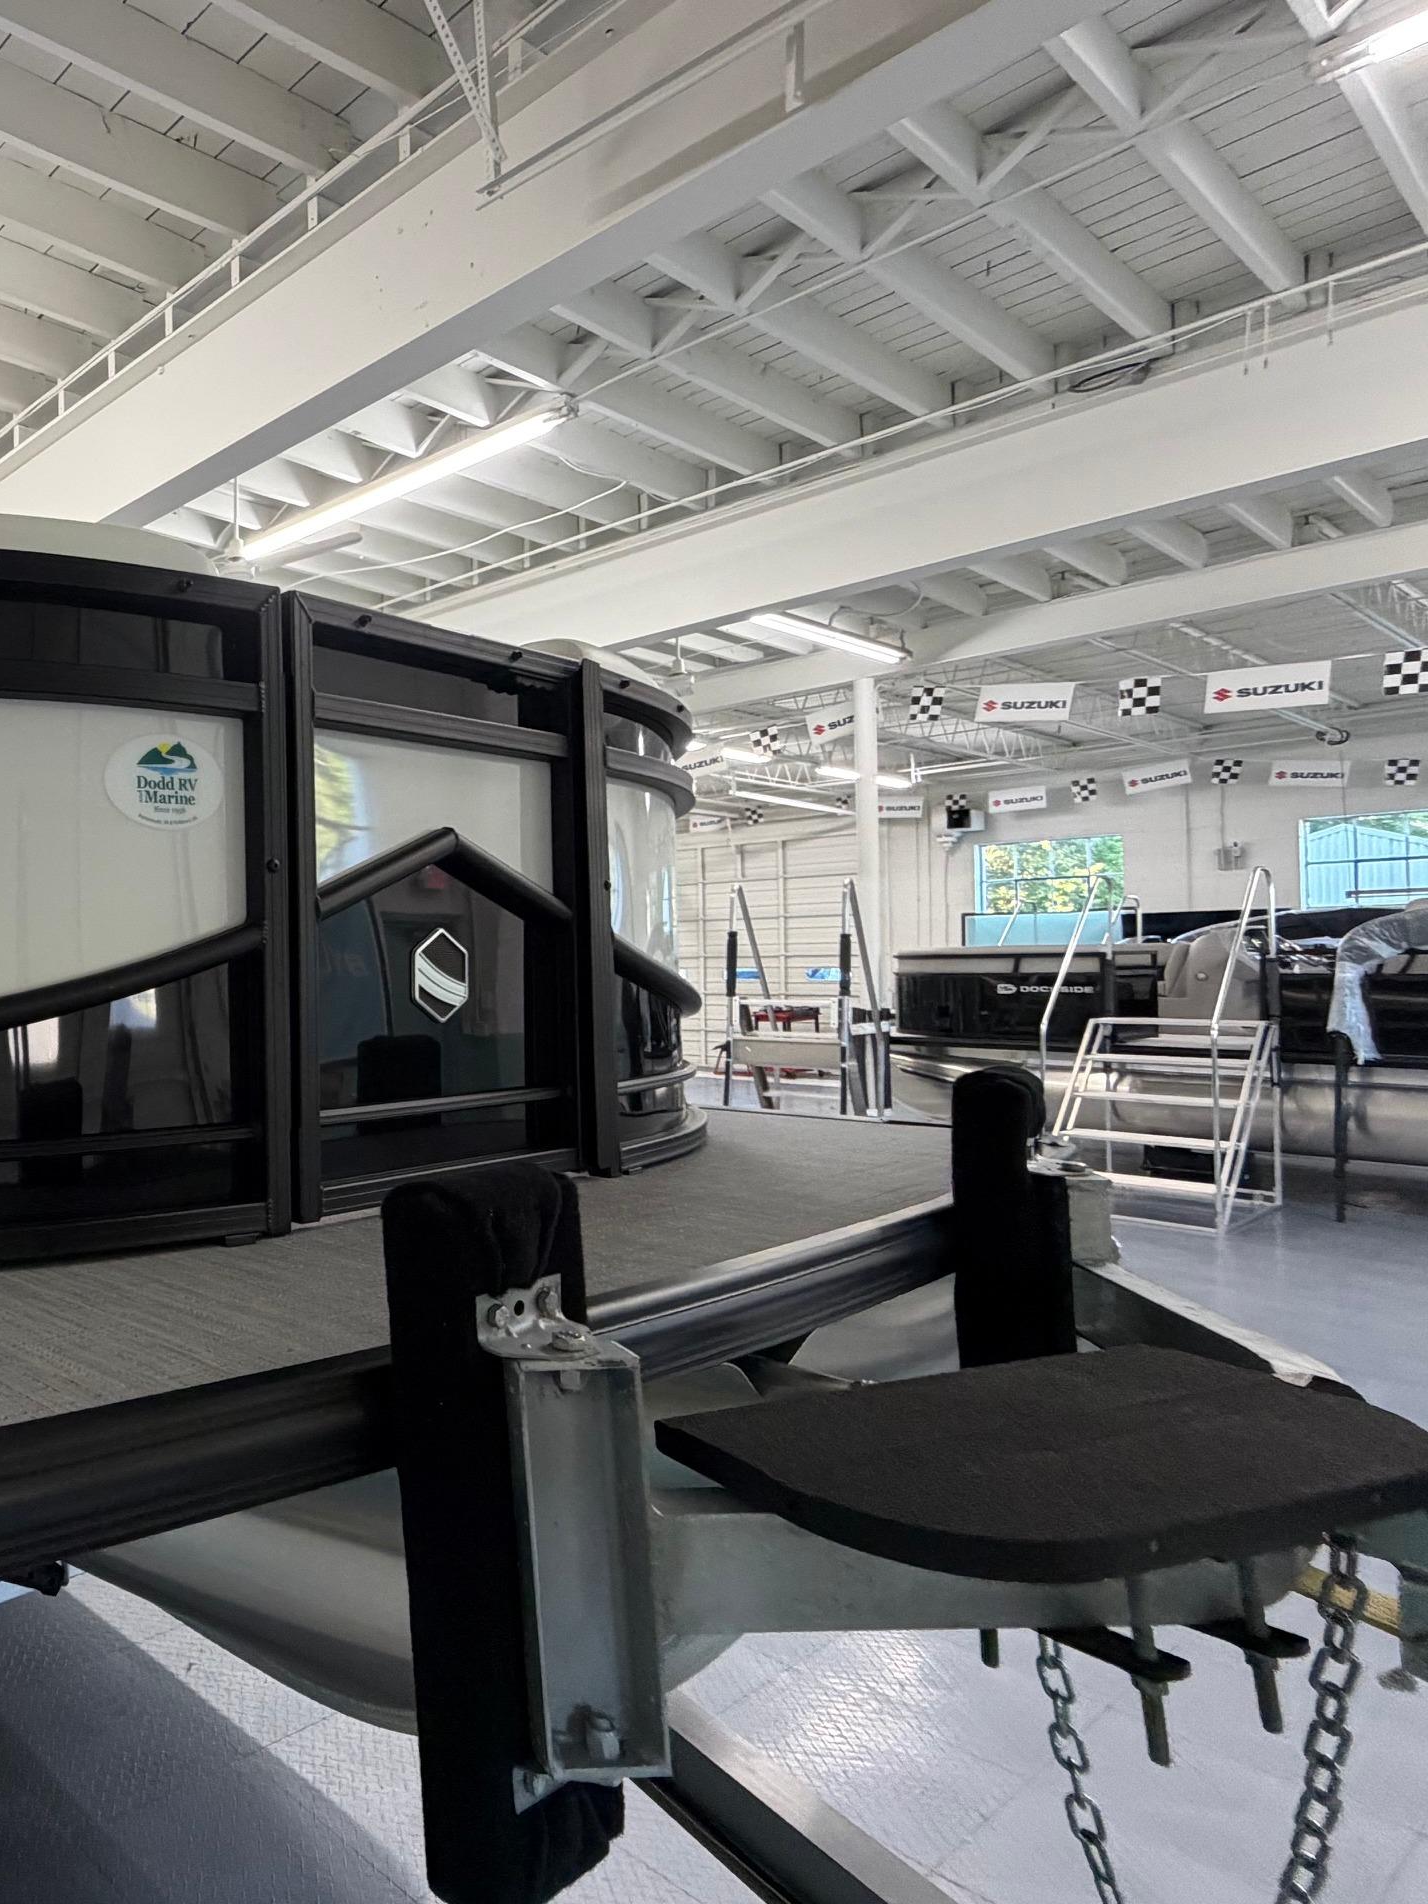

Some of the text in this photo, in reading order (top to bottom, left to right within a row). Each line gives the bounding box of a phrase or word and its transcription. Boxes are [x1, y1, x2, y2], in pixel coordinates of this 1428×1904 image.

[1236, 680, 1324, 698] SUZUKI
[1000, 700, 1067, 710] SUZUKI
[827, 714, 855, 731] SUZ
[136, 775, 198, 791] Dodd RV
[1140, 769, 1188, 785] SUZUKI
[1290, 771, 1344, 780] SUZUKI
[145, 790, 196, 806] Marine
[1003, 795, 1044, 806] SUZUKI
[1019, 985, 1095, 994] DOCSIDE
